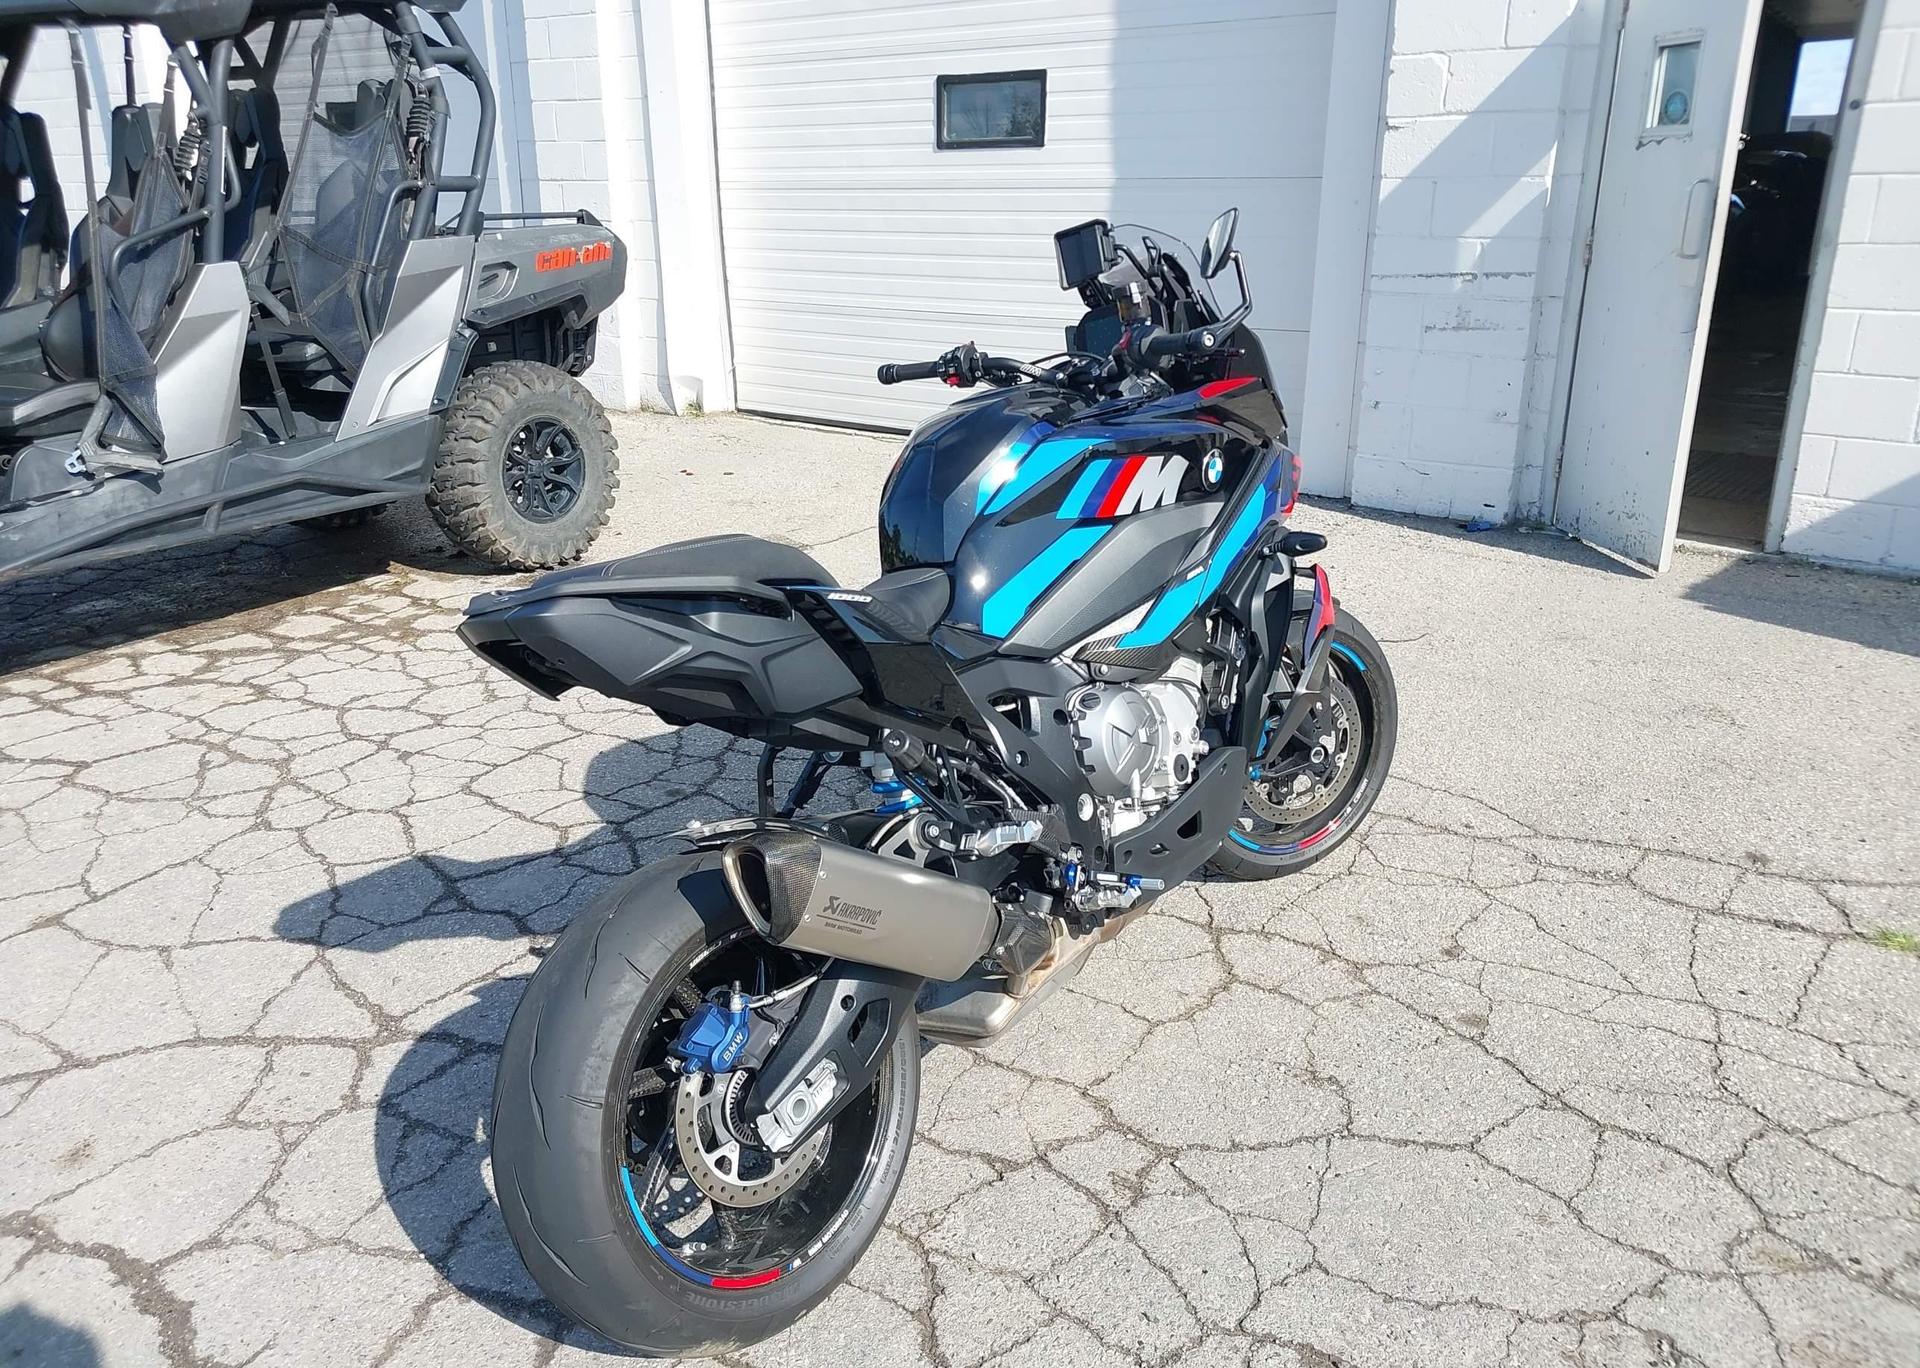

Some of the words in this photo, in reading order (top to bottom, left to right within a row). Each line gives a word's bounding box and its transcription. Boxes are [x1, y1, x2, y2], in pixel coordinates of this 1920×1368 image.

[1114, 455, 1190, 517] M
[723, 1031, 744, 1062] BMW
[684, 1280, 799, 1312] DGESTONE
